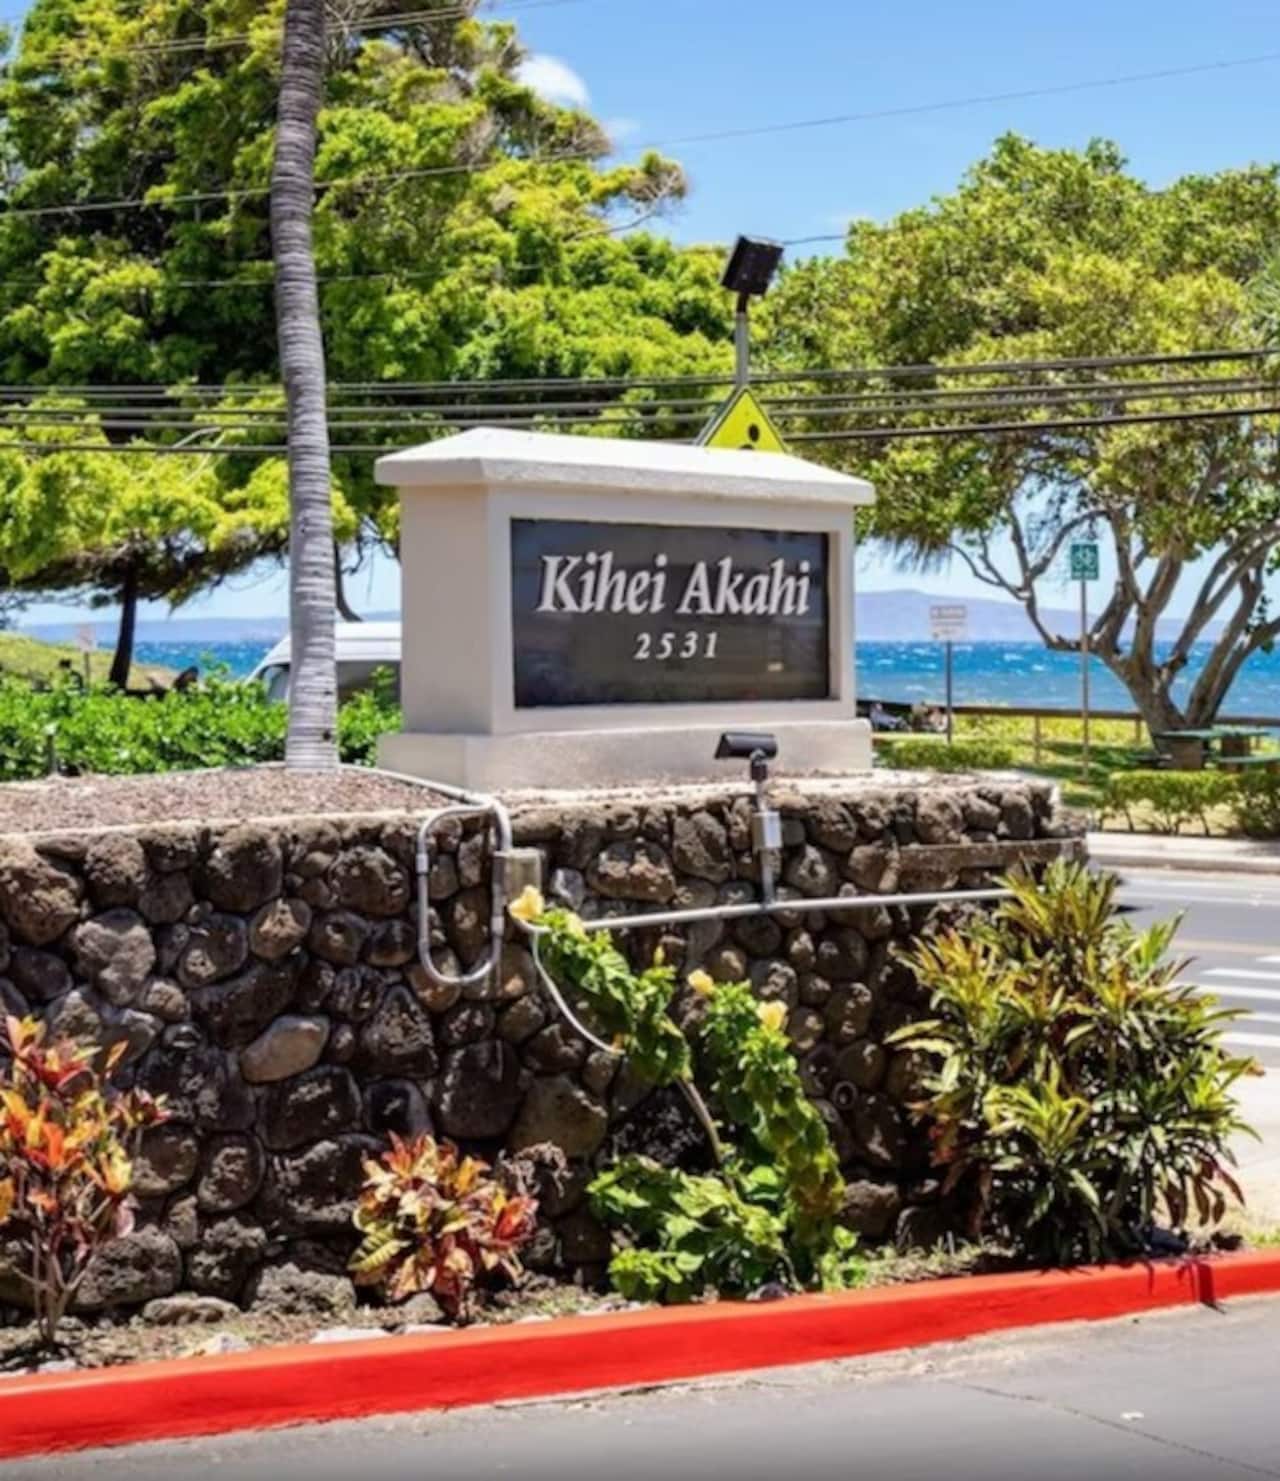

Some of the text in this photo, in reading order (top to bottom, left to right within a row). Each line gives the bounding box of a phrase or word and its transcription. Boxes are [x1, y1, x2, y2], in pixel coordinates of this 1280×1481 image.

[536, 551, 811, 616] Kihei Akahi
[633, 631, 719, 660] 2531
